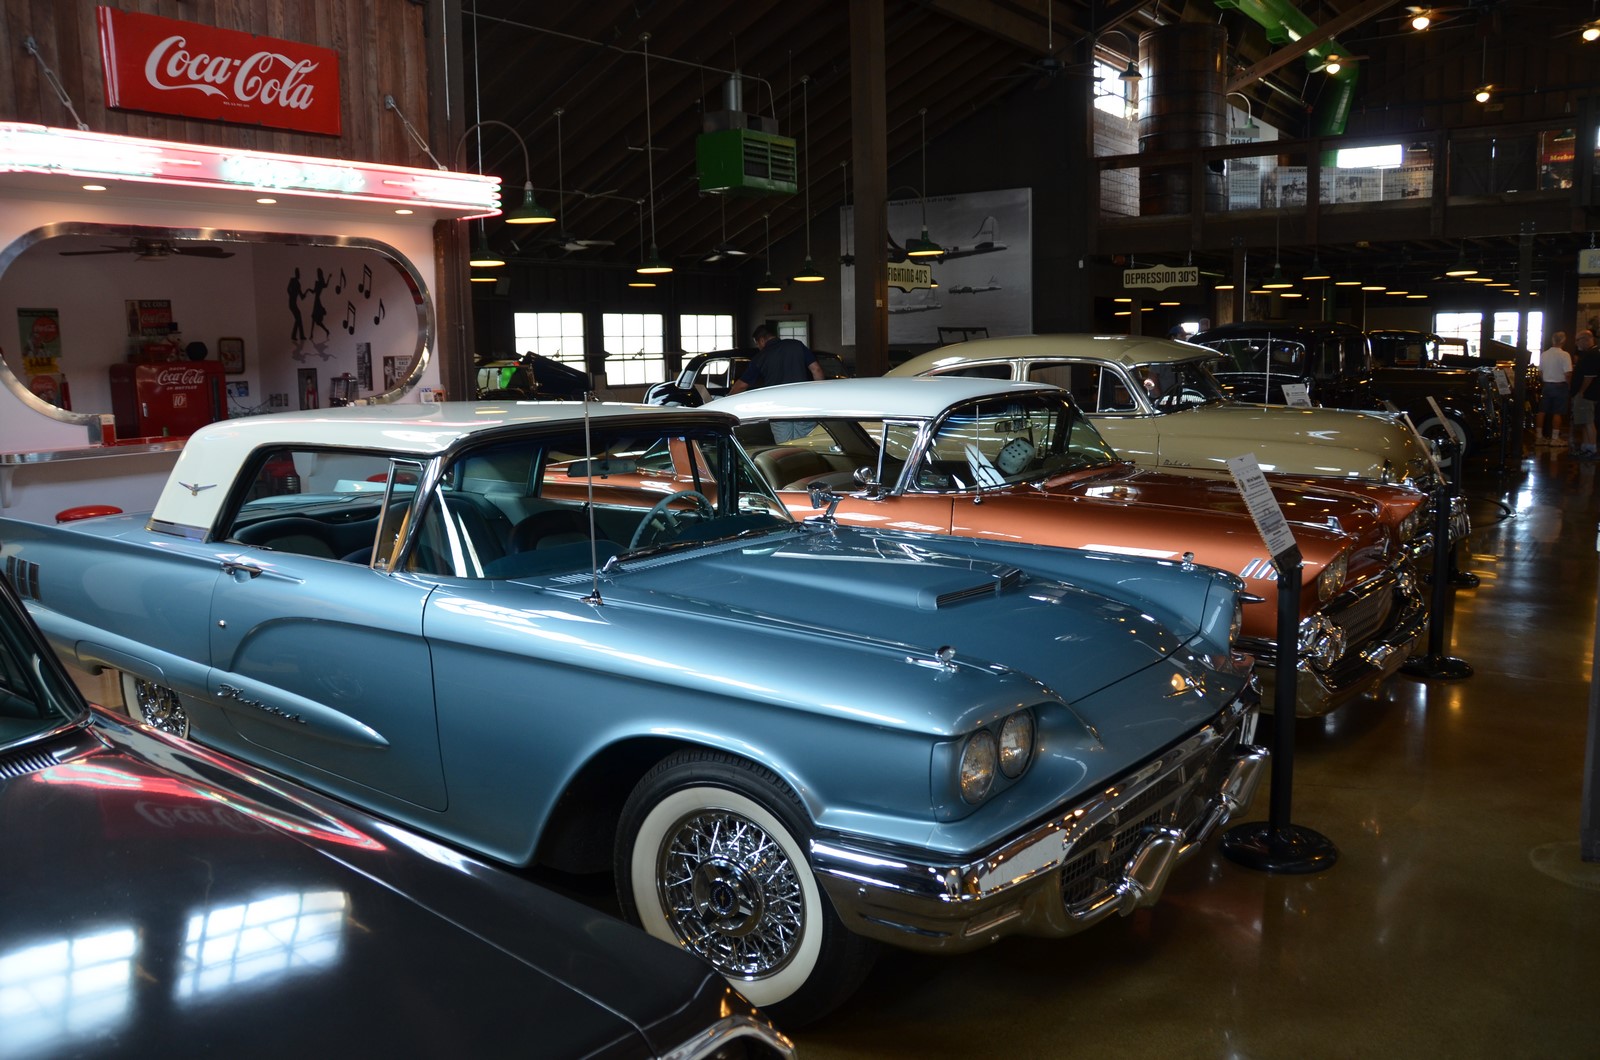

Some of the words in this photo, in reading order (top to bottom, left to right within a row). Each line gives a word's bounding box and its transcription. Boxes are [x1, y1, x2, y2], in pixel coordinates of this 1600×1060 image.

[144, 35, 319, 110] Coca-Cola
[916, 269, 927, 283] 40'S
[1125, 271, 1176, 285] DEPRESSION
[1178, 270, 1197, 283] 30'S
[157, 368, 205, 386] Coca-Cola
